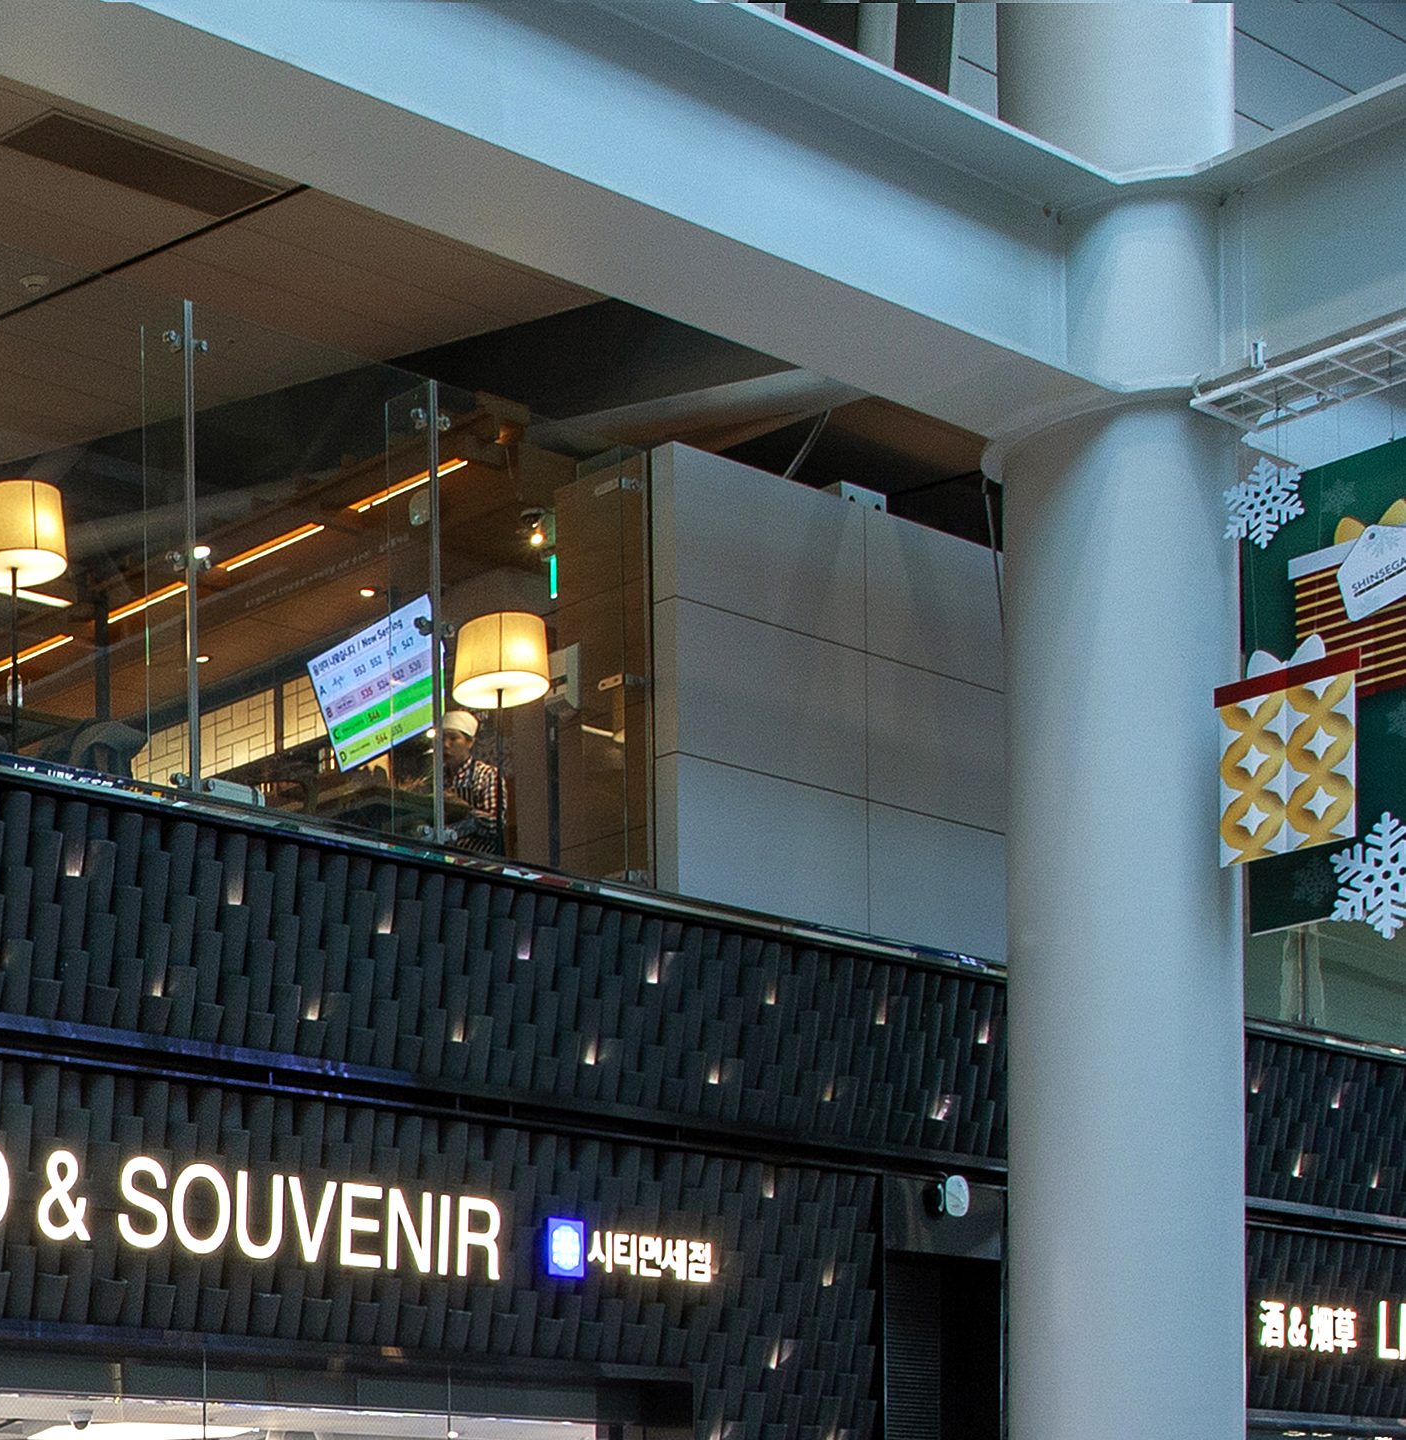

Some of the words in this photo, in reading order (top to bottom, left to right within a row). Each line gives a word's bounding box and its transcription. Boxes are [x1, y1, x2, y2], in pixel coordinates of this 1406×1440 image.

[37, 1147, 92, 1243] &
[116, 1154, 502, 1281] SOUVENIR
[587, 1229, 713, 1283] 시티면세점
